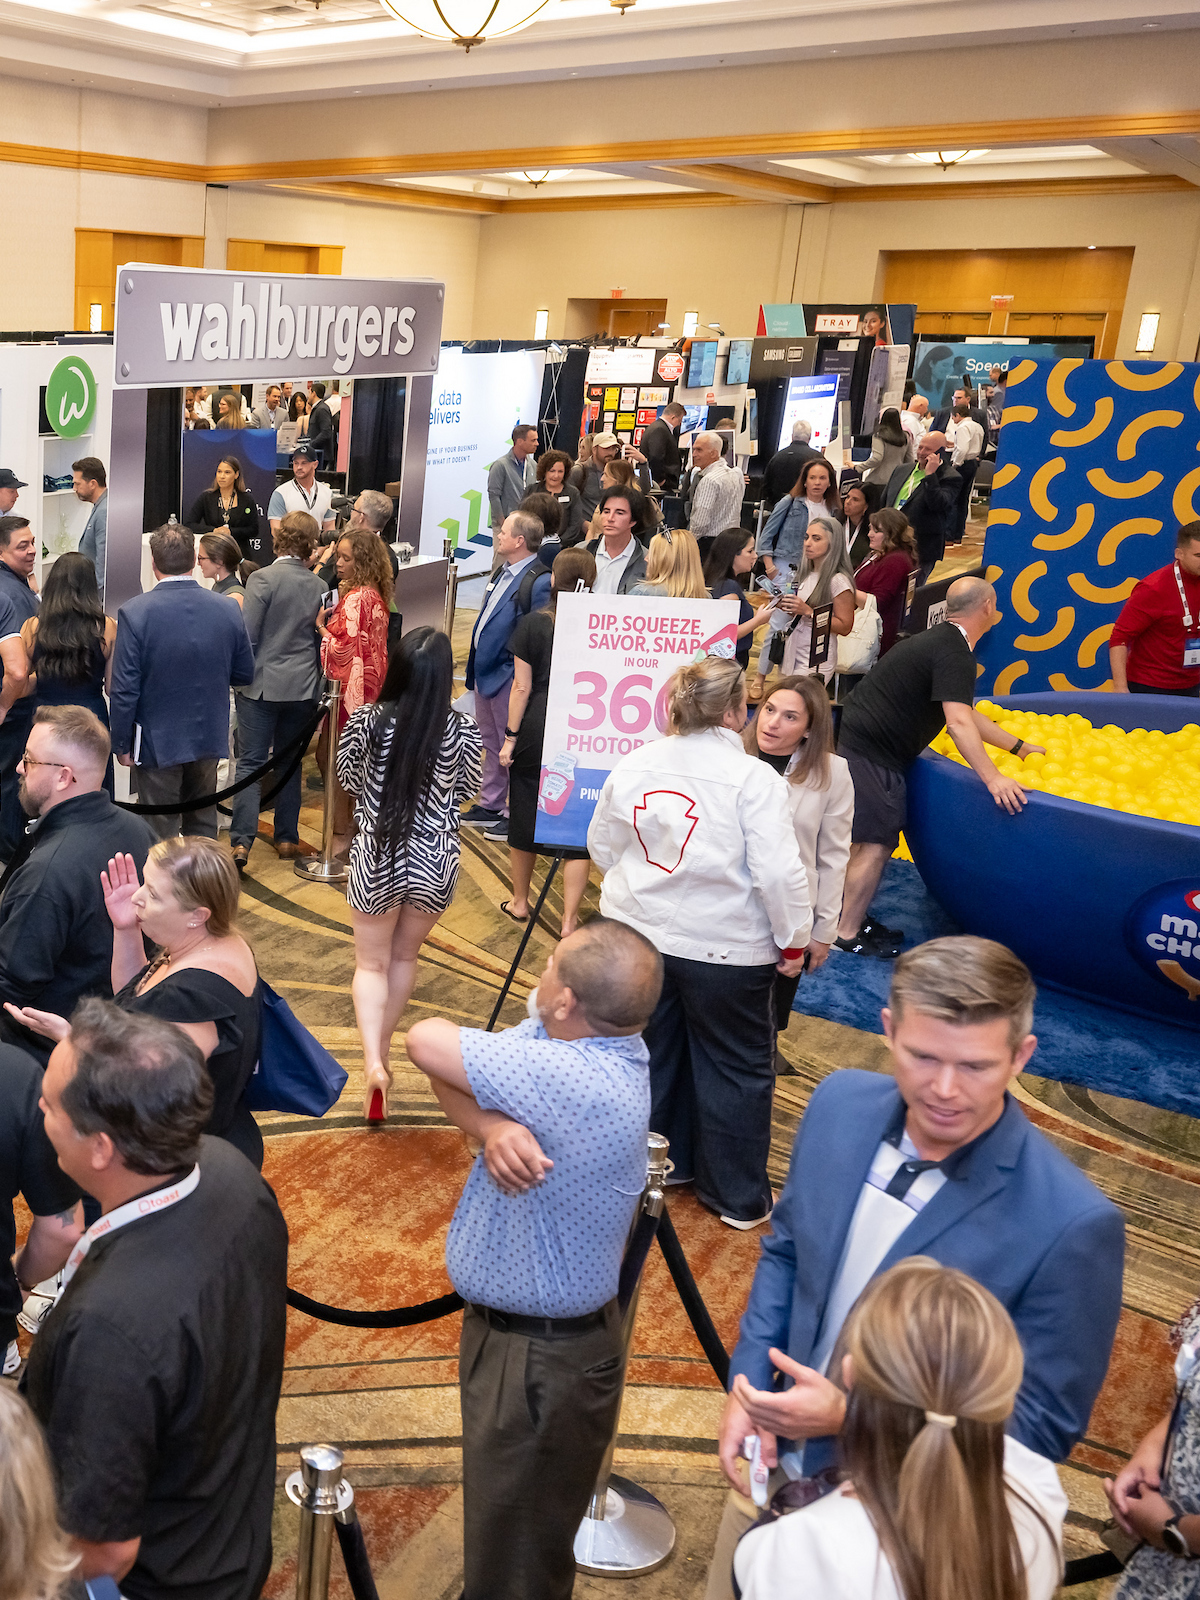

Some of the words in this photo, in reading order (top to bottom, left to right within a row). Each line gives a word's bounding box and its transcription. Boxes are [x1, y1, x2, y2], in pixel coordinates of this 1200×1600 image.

[160, 281, 417, 374] wahlburgers
[822, 319, 852, 327] TRAY
[764, 349, 784, 361] SAMSUNG
[439, 390, 462, 406] data
[430, 408, 460, 424] elivers
[588, 614, 618, 632] DIP,
[622, 616, 705, 637] SQUEEZE,
[588, 633, 650, 654] SAVOR,
[652, 636, 701, 654] SNAP
[624, 657, 635, 667] IN
[636, 658, 658, 668] OUR
[566, 734, 653, 756] PHOTOB
[580, 788, 602, 800] PIN
[1160, 914, 1200, 938] m
[150, 1190, 180, 1208] toast
